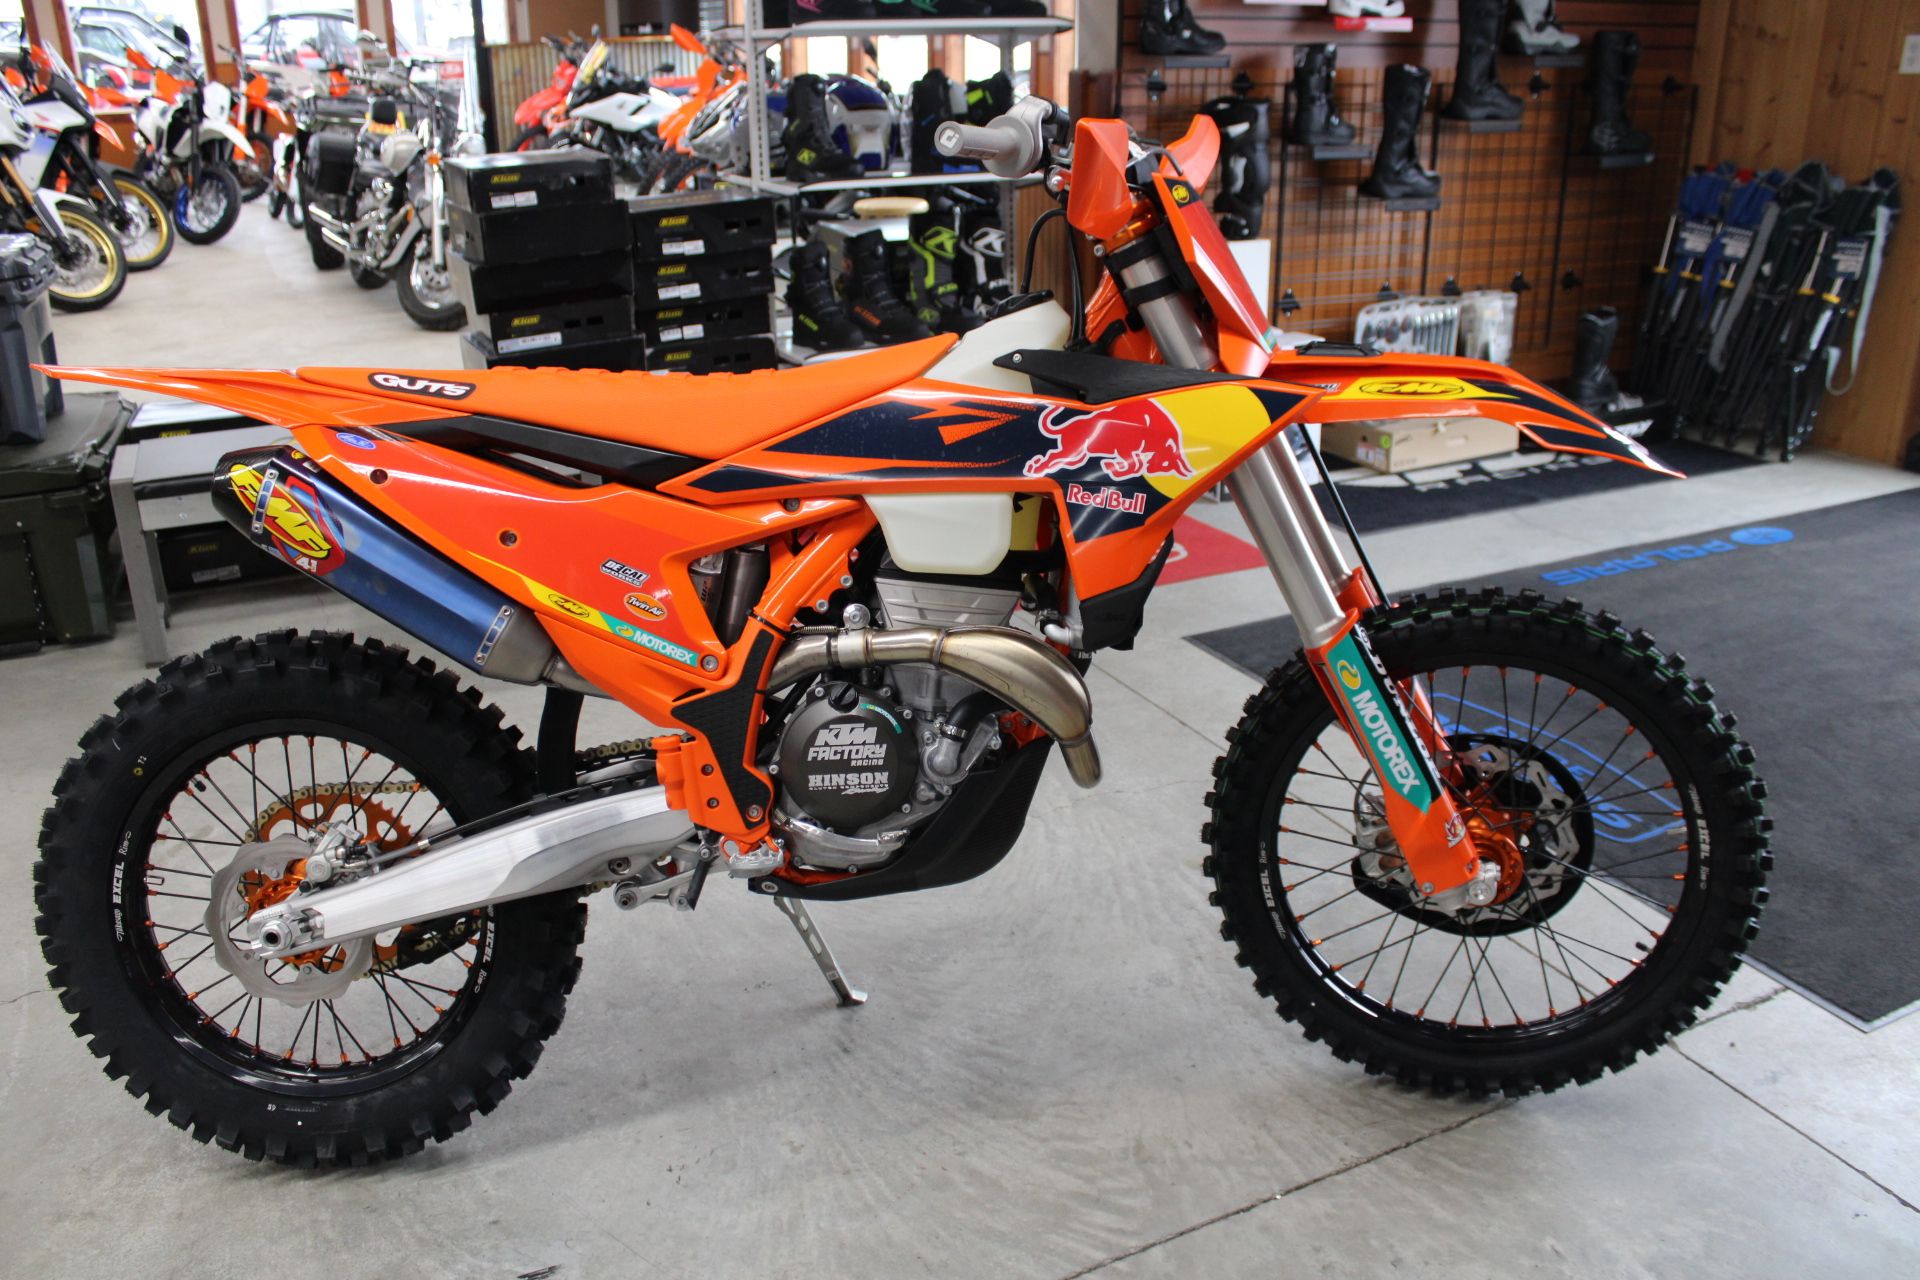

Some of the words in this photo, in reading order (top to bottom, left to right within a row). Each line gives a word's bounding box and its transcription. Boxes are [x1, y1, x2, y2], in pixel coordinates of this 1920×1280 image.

[373, 374, 470, 396] GUTS
[1360, 381, 1465, 396] FMF
[1067, 483, 1107, 508] Red
[1106, 489, 1146, 514] Bull
[1539, 539, 1737, 586] POLARIS
[628, 596, 651, 612] Twin
[649, 604, 665, 617] Air
[633, 631, 694, 664] MOTOREX
[814, 723, 878, 746] KTM
[1352, 689, 1421, 795] MOTOREX
[807, 744, 887, 761] FACTORY
[850, 758, 884, 767] RACING
[808, 772, 889, 787] HINSON
[112, 862, 124, 904] EXCEL
[1261, 869, 1275, 907] EXCEL
[483, 921, 495, 963] EXCEL
